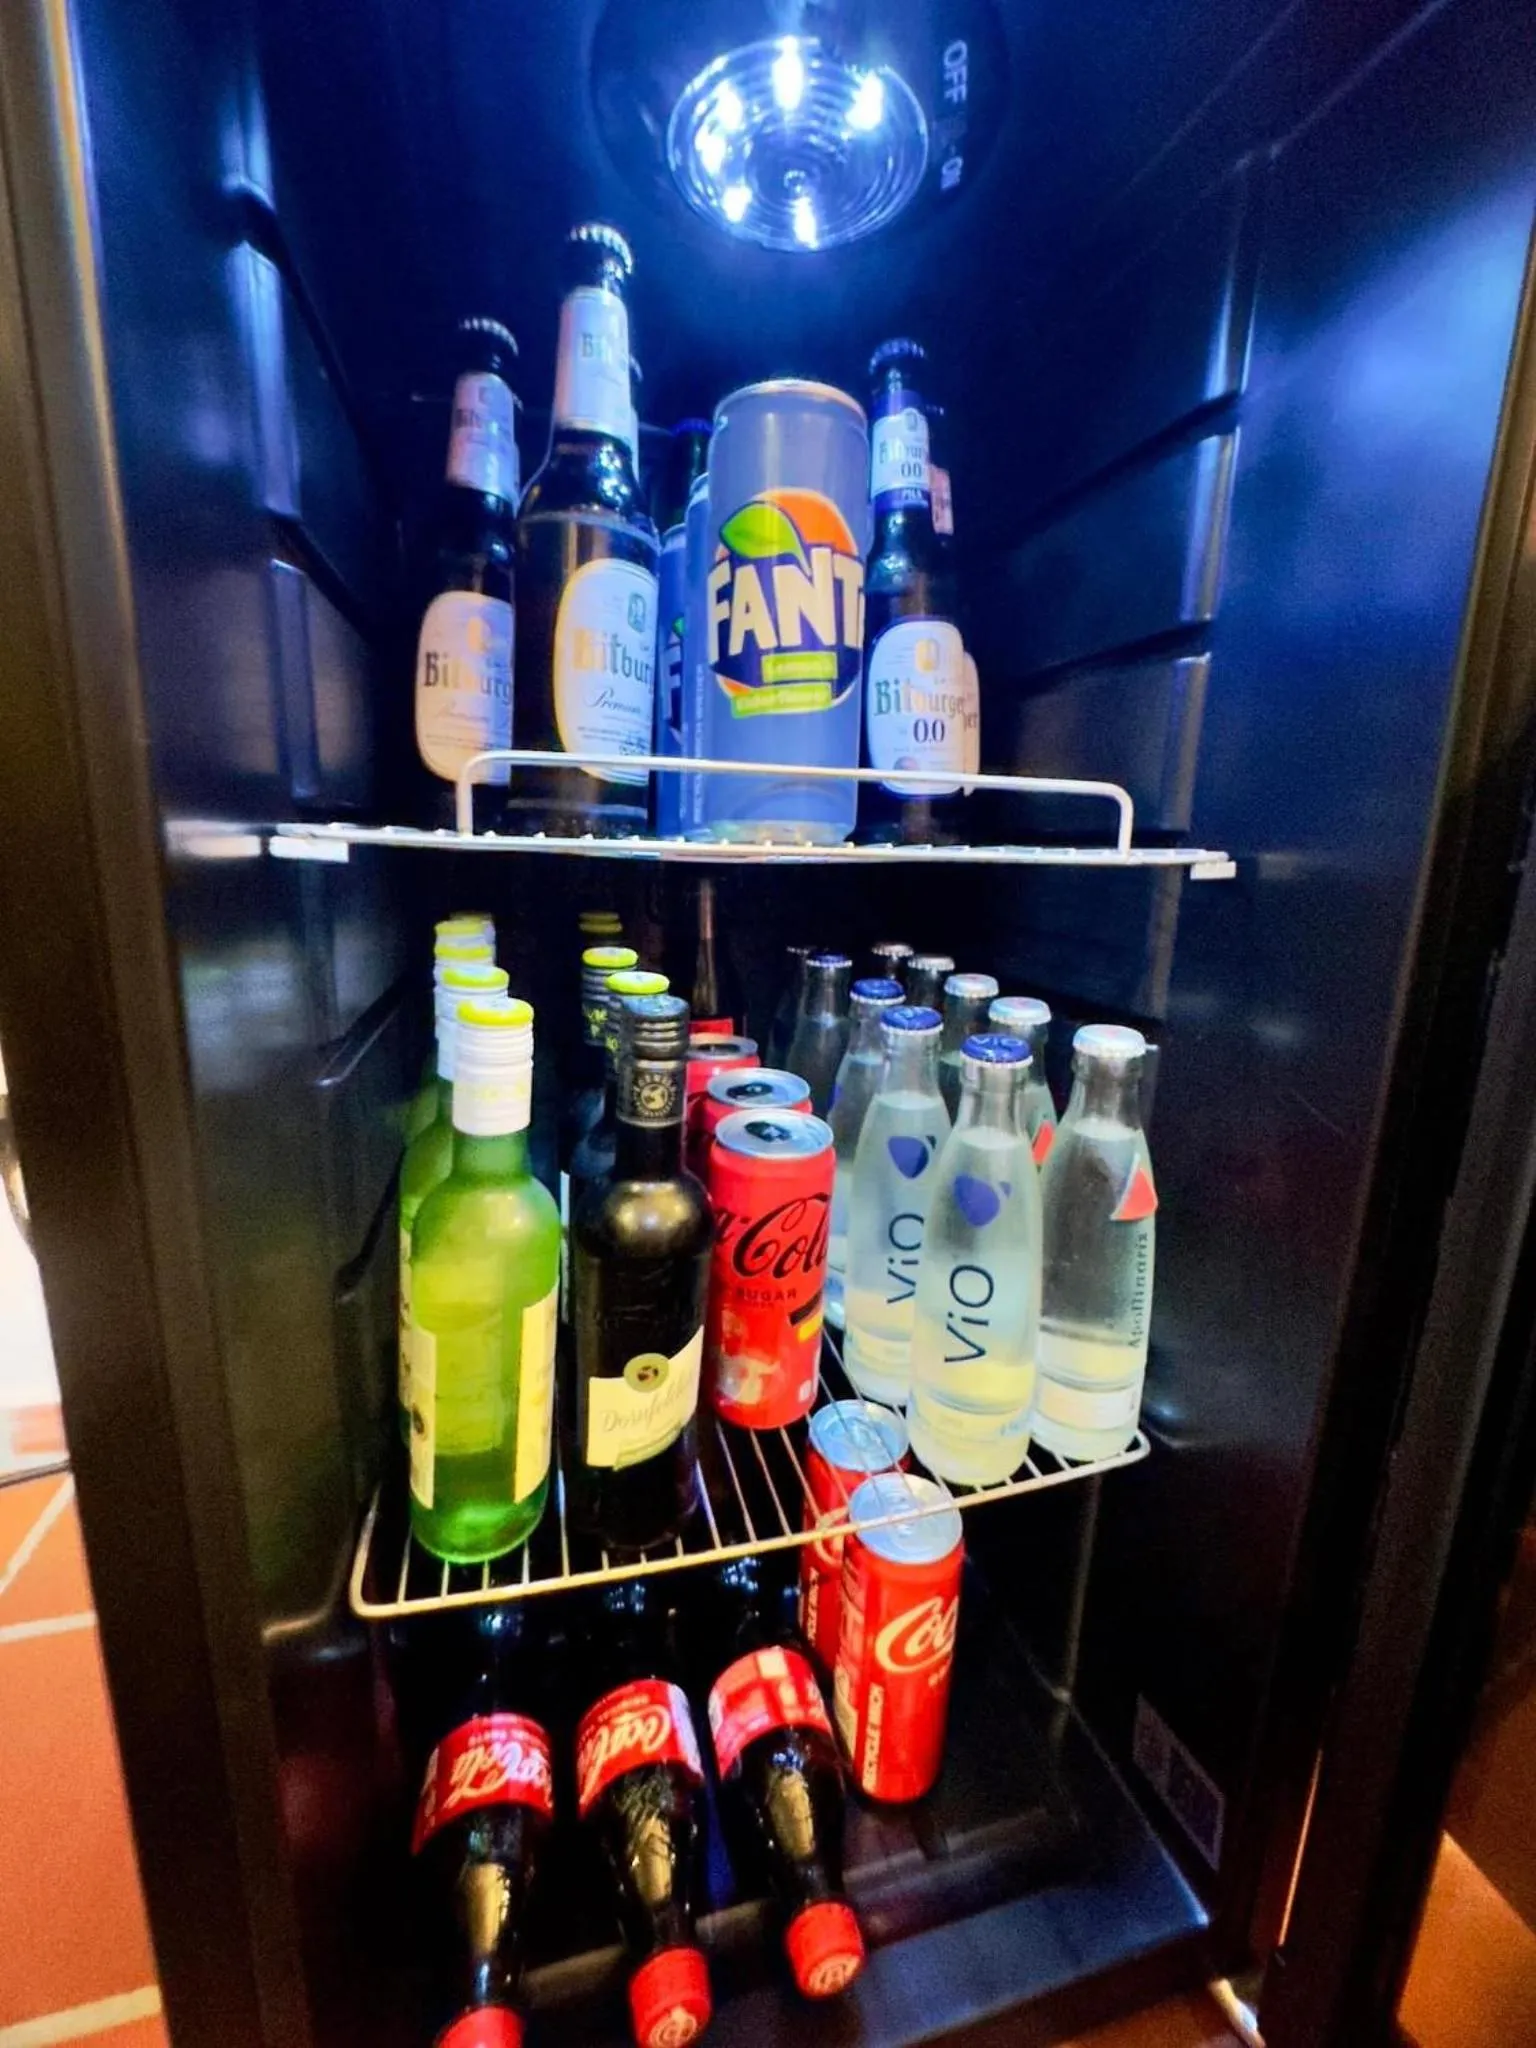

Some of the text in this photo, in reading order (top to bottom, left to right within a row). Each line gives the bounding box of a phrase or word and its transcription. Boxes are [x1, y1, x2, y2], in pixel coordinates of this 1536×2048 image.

[943, 39, 968, 103] OFF
[707, 547, 866, 666] FANT
[912, 718, 946, 744] 0.0
[1128, 1232, 1150, 1348] Apollinaris
